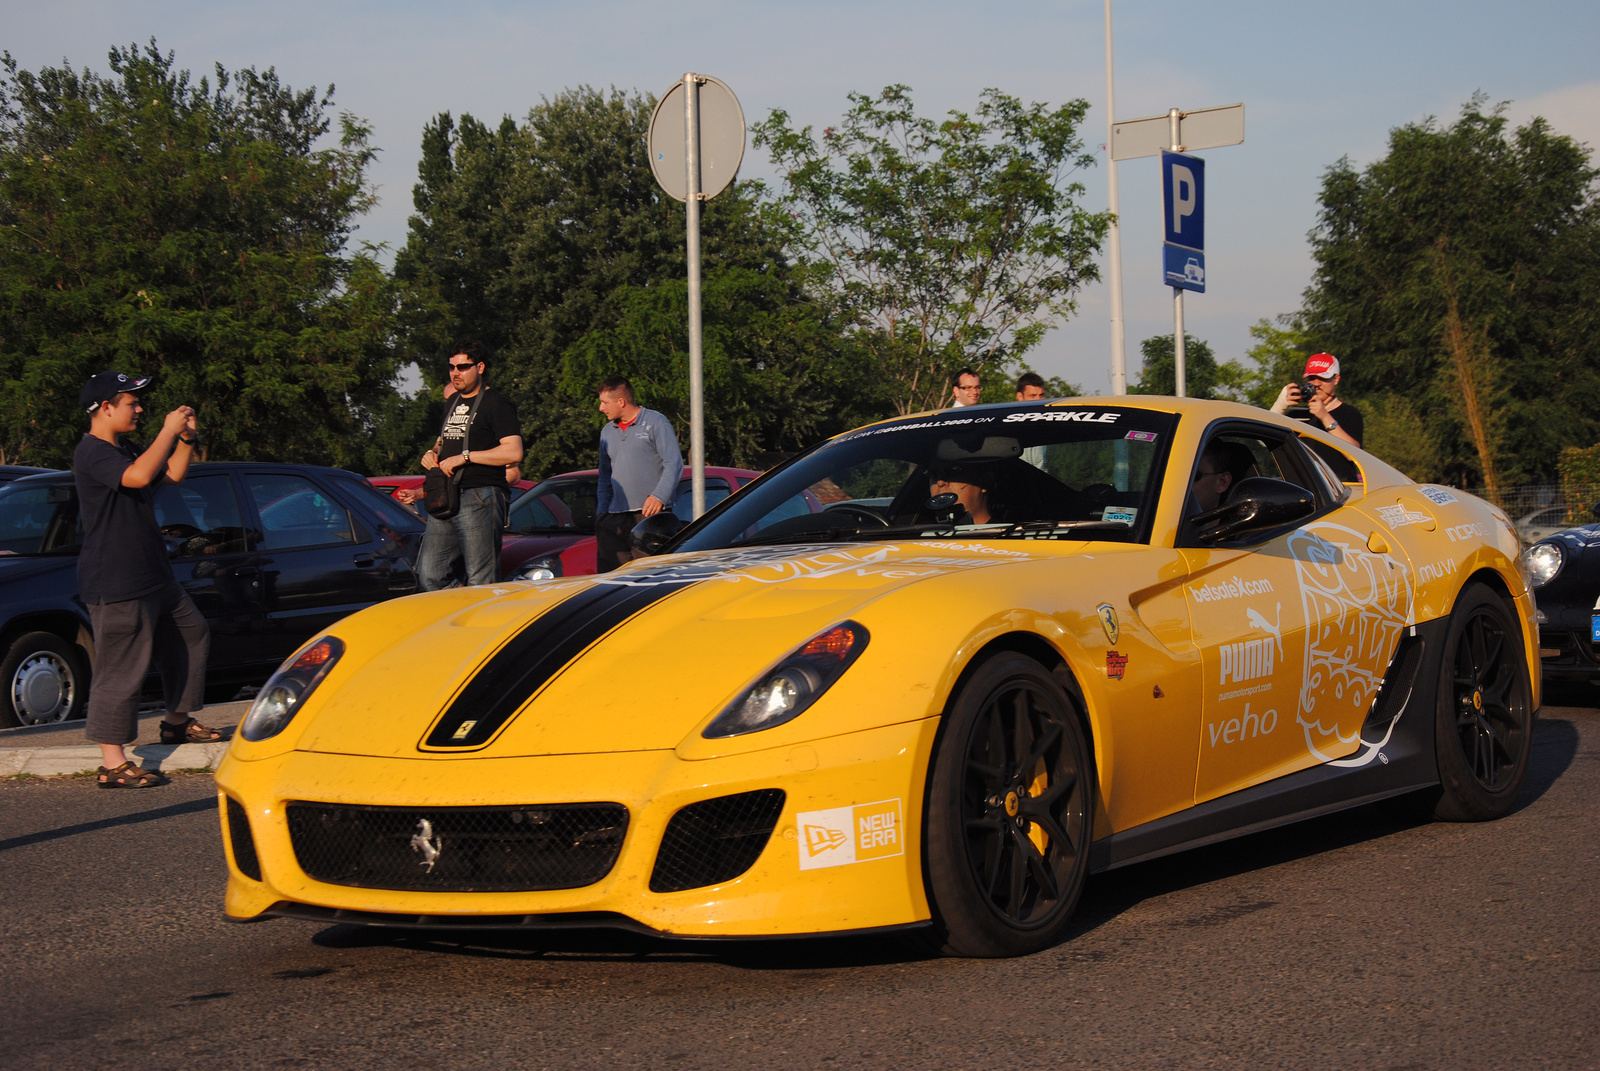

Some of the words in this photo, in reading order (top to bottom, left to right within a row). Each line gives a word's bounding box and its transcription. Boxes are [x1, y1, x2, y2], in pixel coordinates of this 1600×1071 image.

[1171, 163, 1196, 234] P
[974, 416, 996, 424] ON
[1002, 411, 1122, 424] SPARKLE
[1444, 523, 1483, 543] INCIPIO
[1219, 636, 1275, 686] PUMA
[1218, 682, 1273, 704] pumamotorsport.com
[1208, 702, 1278, 749] veho
[858, 811, 896, 834] NEW
[860, 828, 897, 850] ERA
